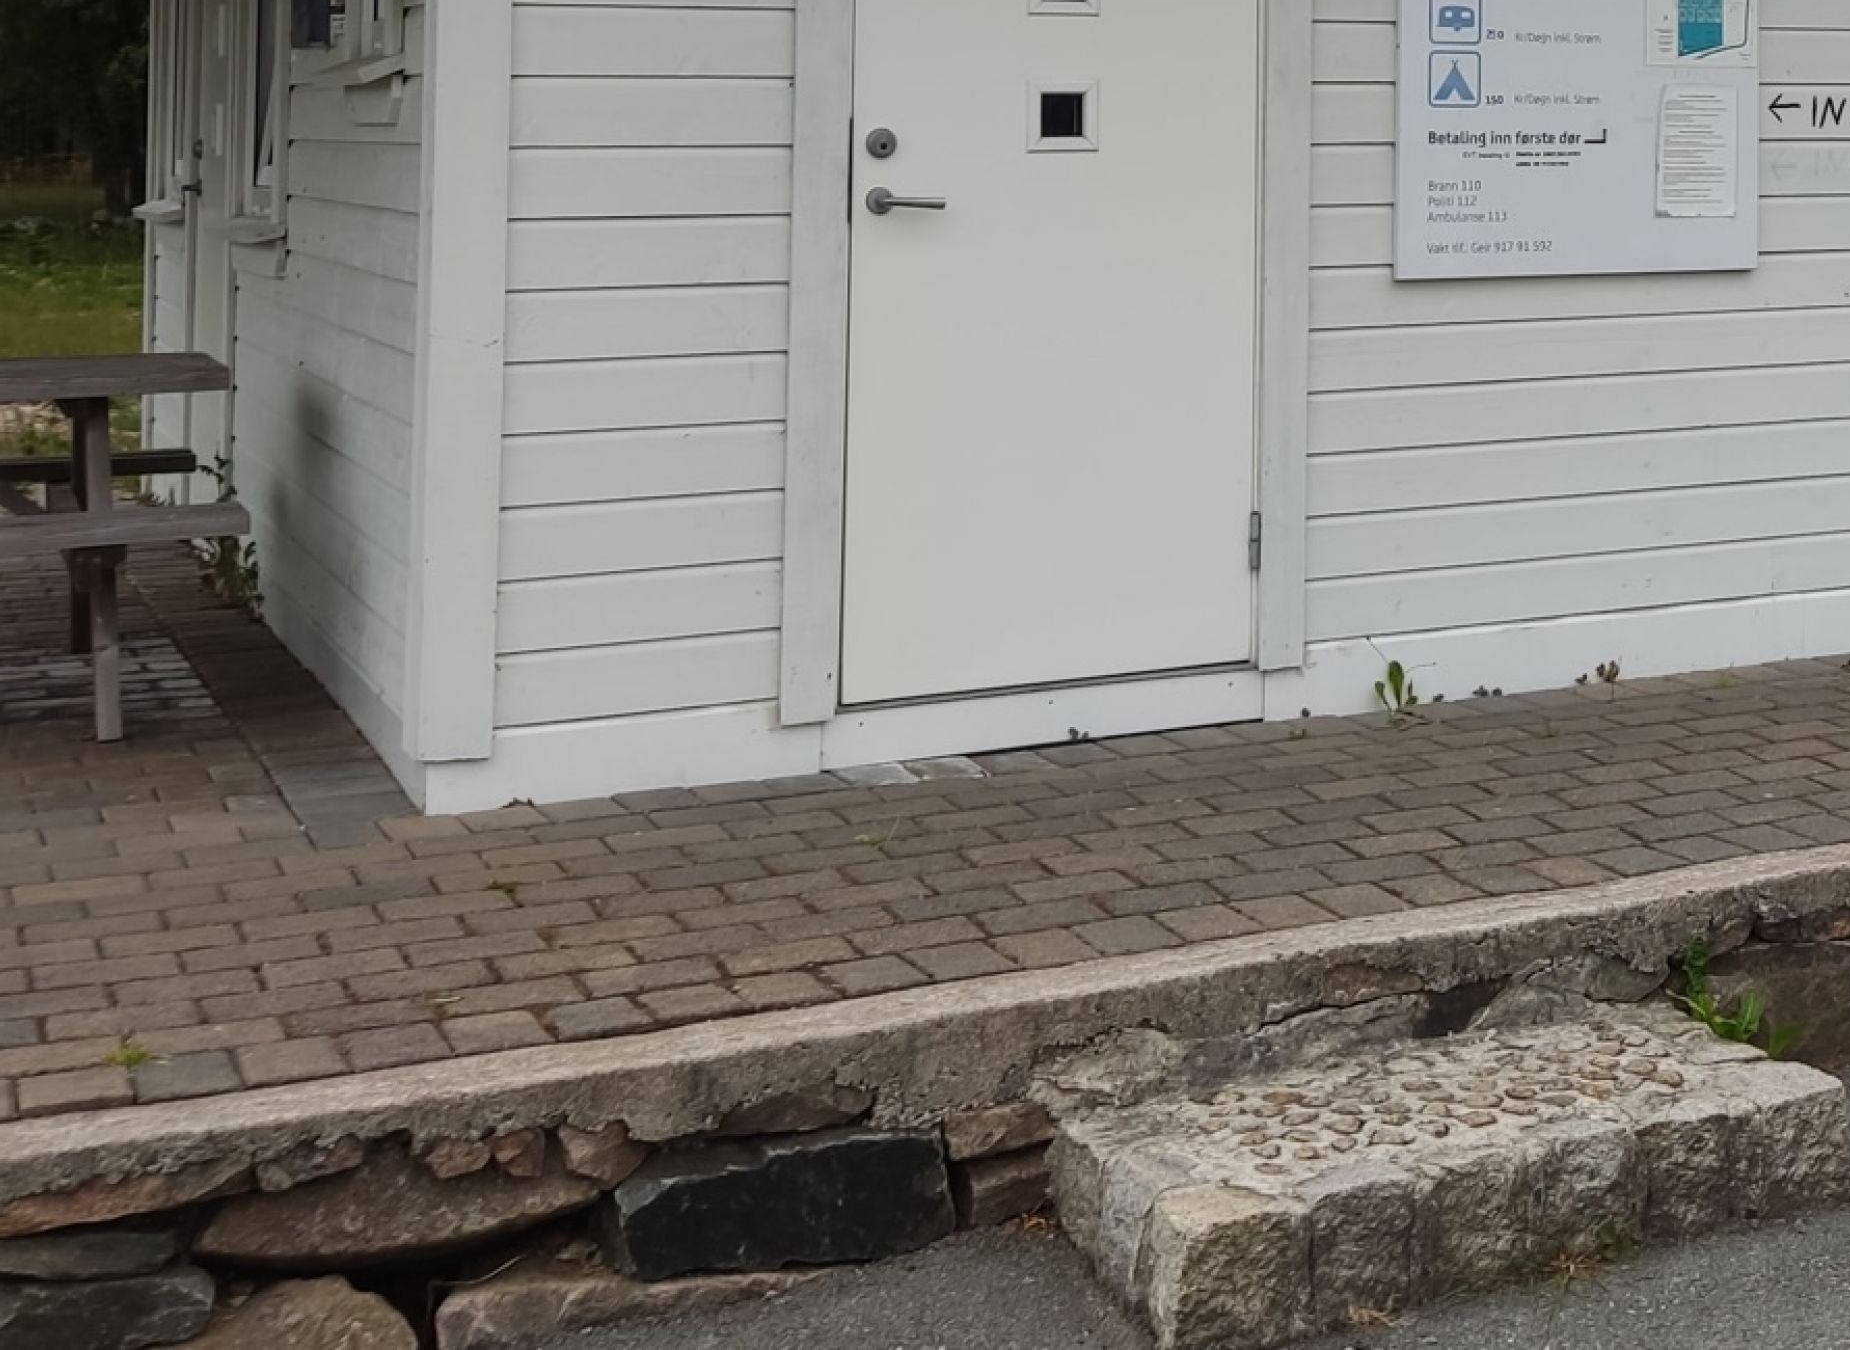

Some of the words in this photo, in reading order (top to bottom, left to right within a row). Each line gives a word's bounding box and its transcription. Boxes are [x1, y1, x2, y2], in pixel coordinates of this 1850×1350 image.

[1428, 130, 1486, 148] Betaling
[1490, 130, 1512, 144] inn
[1515, 130, 1556, 144] første
[1559, 131, 1582, 144] dør
[1428, 180, 1458, 191] Brann
[1461, 180, 1482, 191] 110
[1428, 195, 1455, 207] Politi
[1457, 195, 1478, 206] 112
[1427, 210, 1486, 223] Ambulanse
